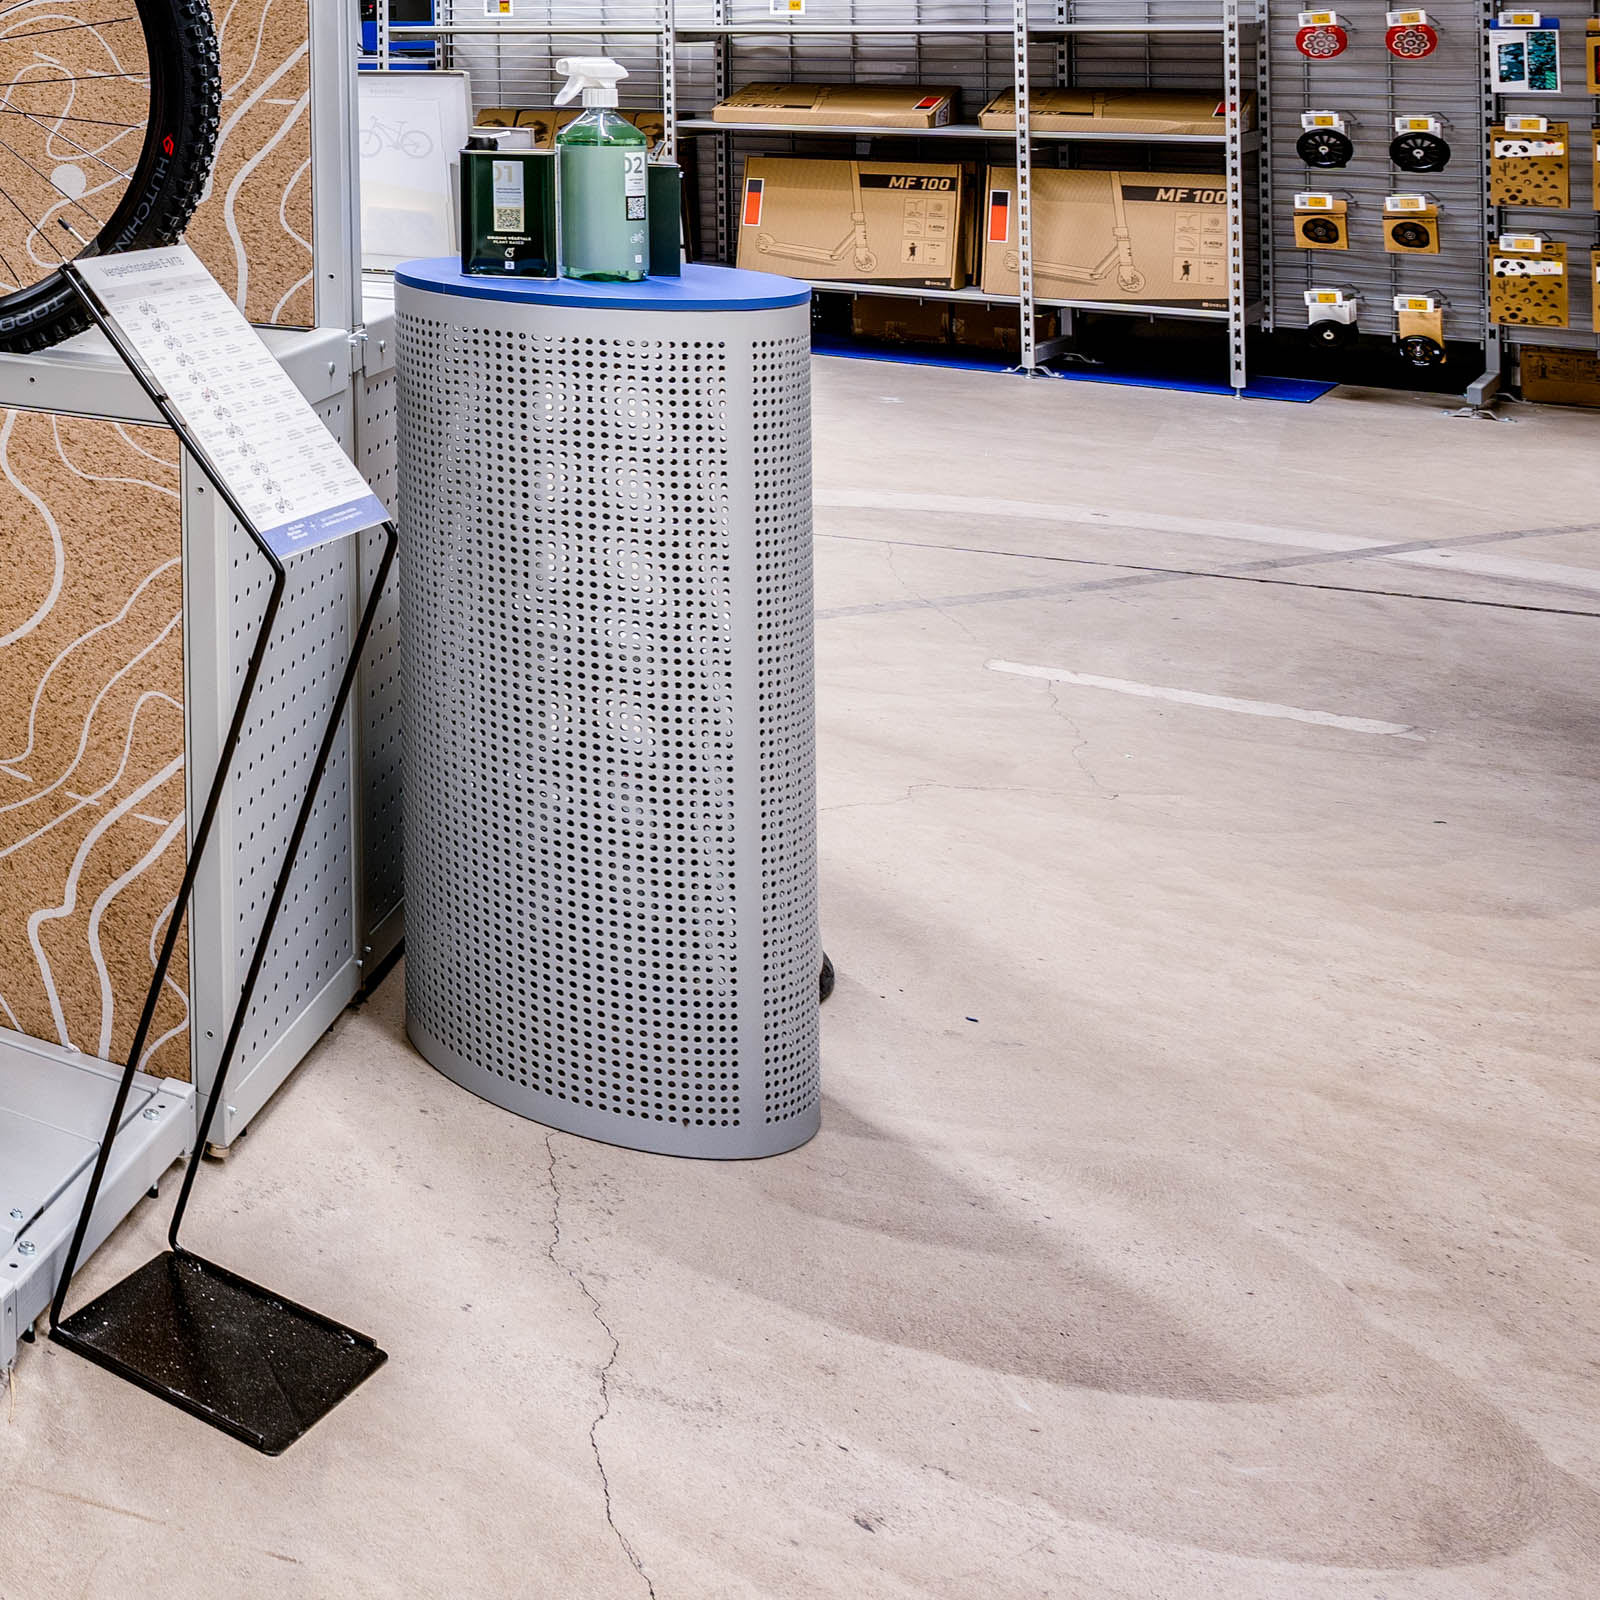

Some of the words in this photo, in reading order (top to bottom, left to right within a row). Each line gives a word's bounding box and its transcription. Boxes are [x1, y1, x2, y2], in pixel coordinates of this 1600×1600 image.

[888, 176, 916, 190] MF
[919, 177, 951, 191] 100
[1155, 188, 1188, 203] MF
[1193, 189, 1227, 204] 100
[109, 156, 170, 254] HUTCHIN
